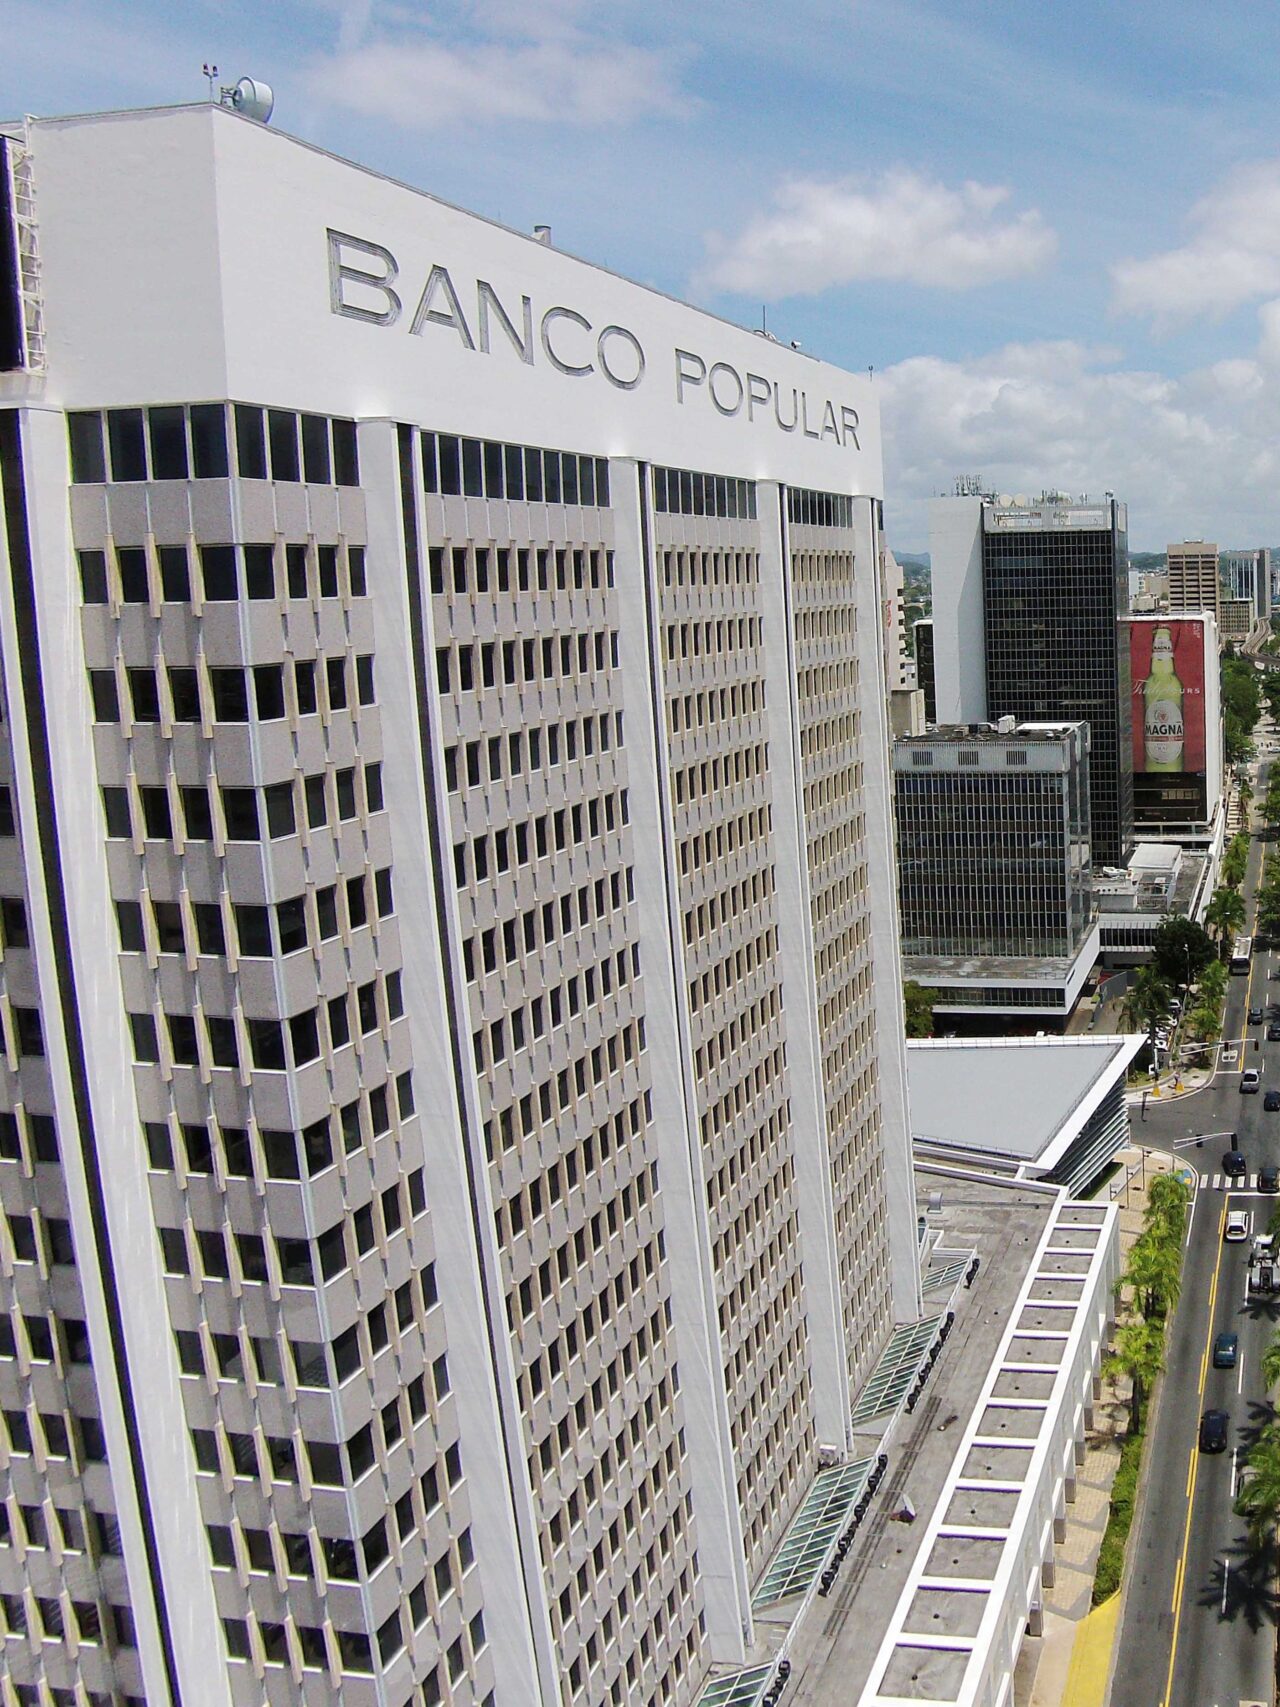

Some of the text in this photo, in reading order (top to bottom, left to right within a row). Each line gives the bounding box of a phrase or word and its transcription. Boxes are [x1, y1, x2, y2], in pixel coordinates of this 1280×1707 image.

[326, 227, 861, 451] BANCO POPULAR
[1145, 724, 1183, 736] MAGNA
